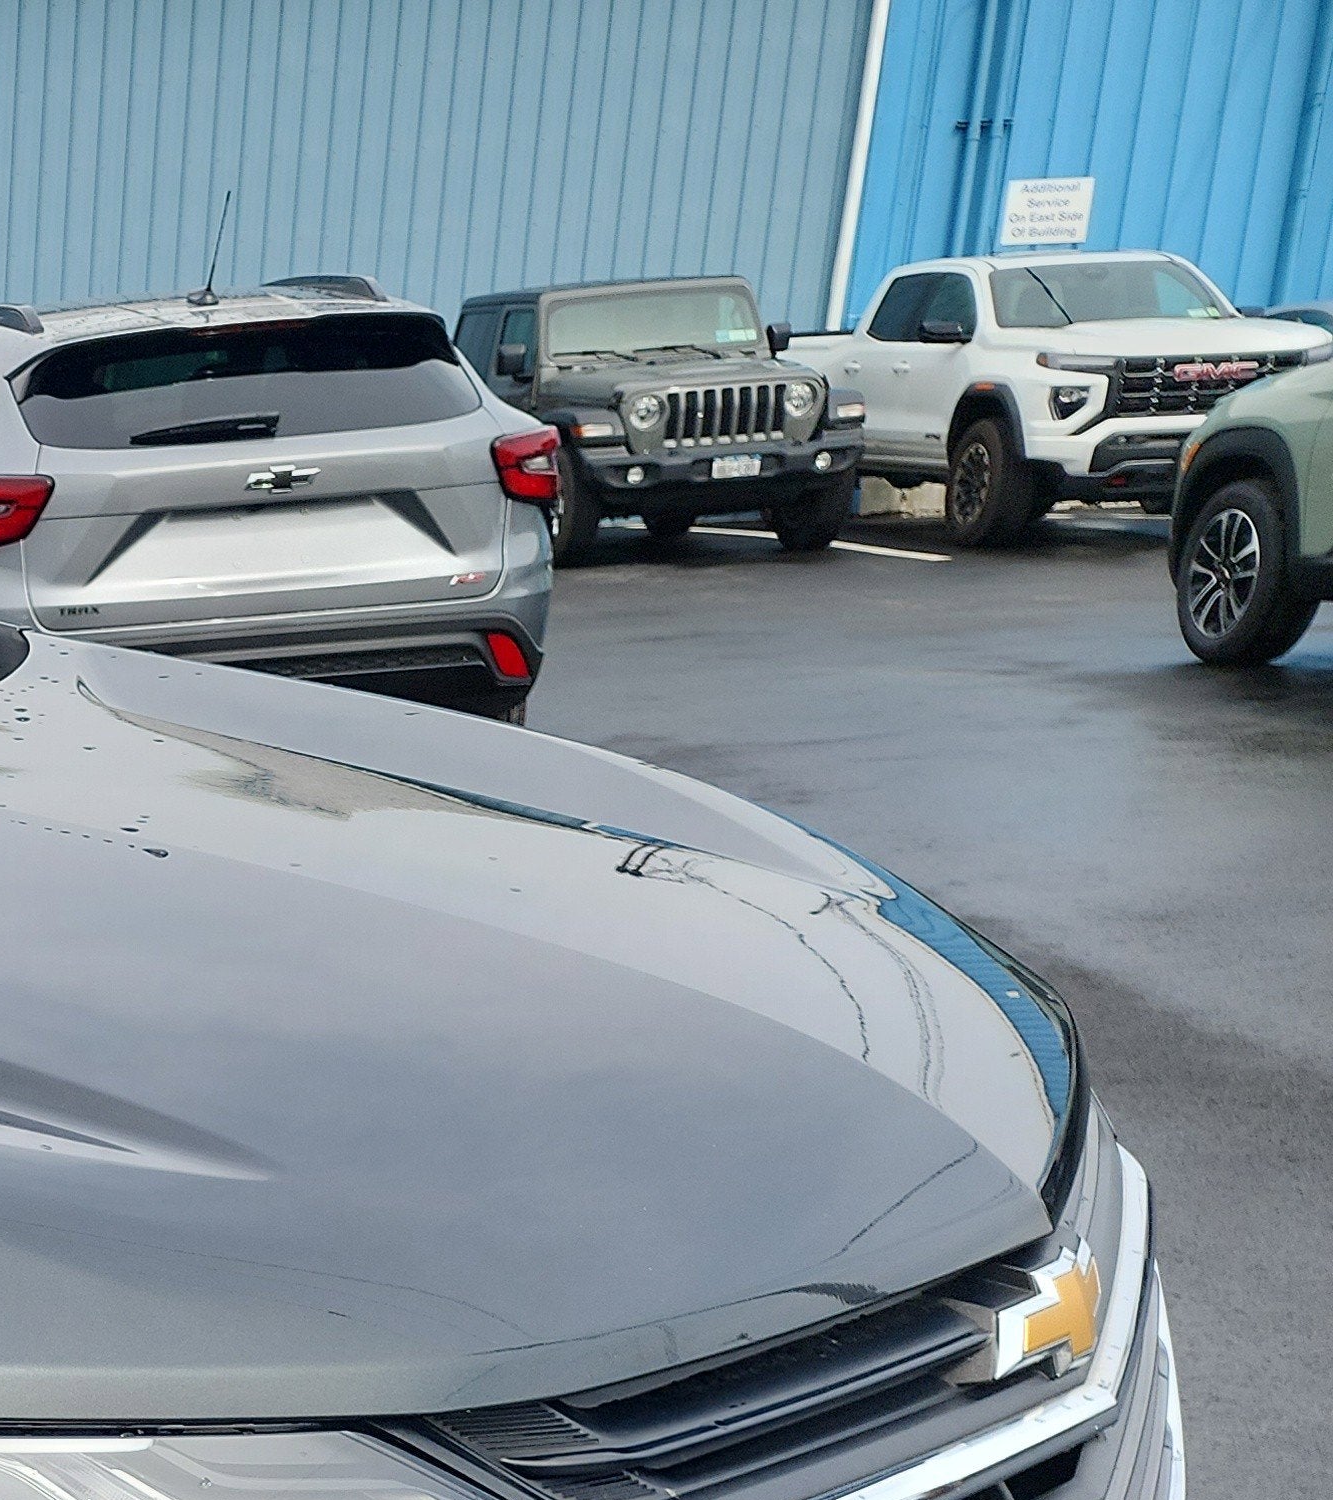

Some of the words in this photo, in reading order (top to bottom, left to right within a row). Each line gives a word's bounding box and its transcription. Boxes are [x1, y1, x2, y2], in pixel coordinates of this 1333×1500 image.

[1026, 198, 1071, 209] Service
[1008, 212, 1027, 224] On
[1029, 211, 1055, 223] East
[1058, 210, 1084, 222] Side
[1029, 225, 1077, 238] Building
[1174, 361, 1259, 382] GMC
